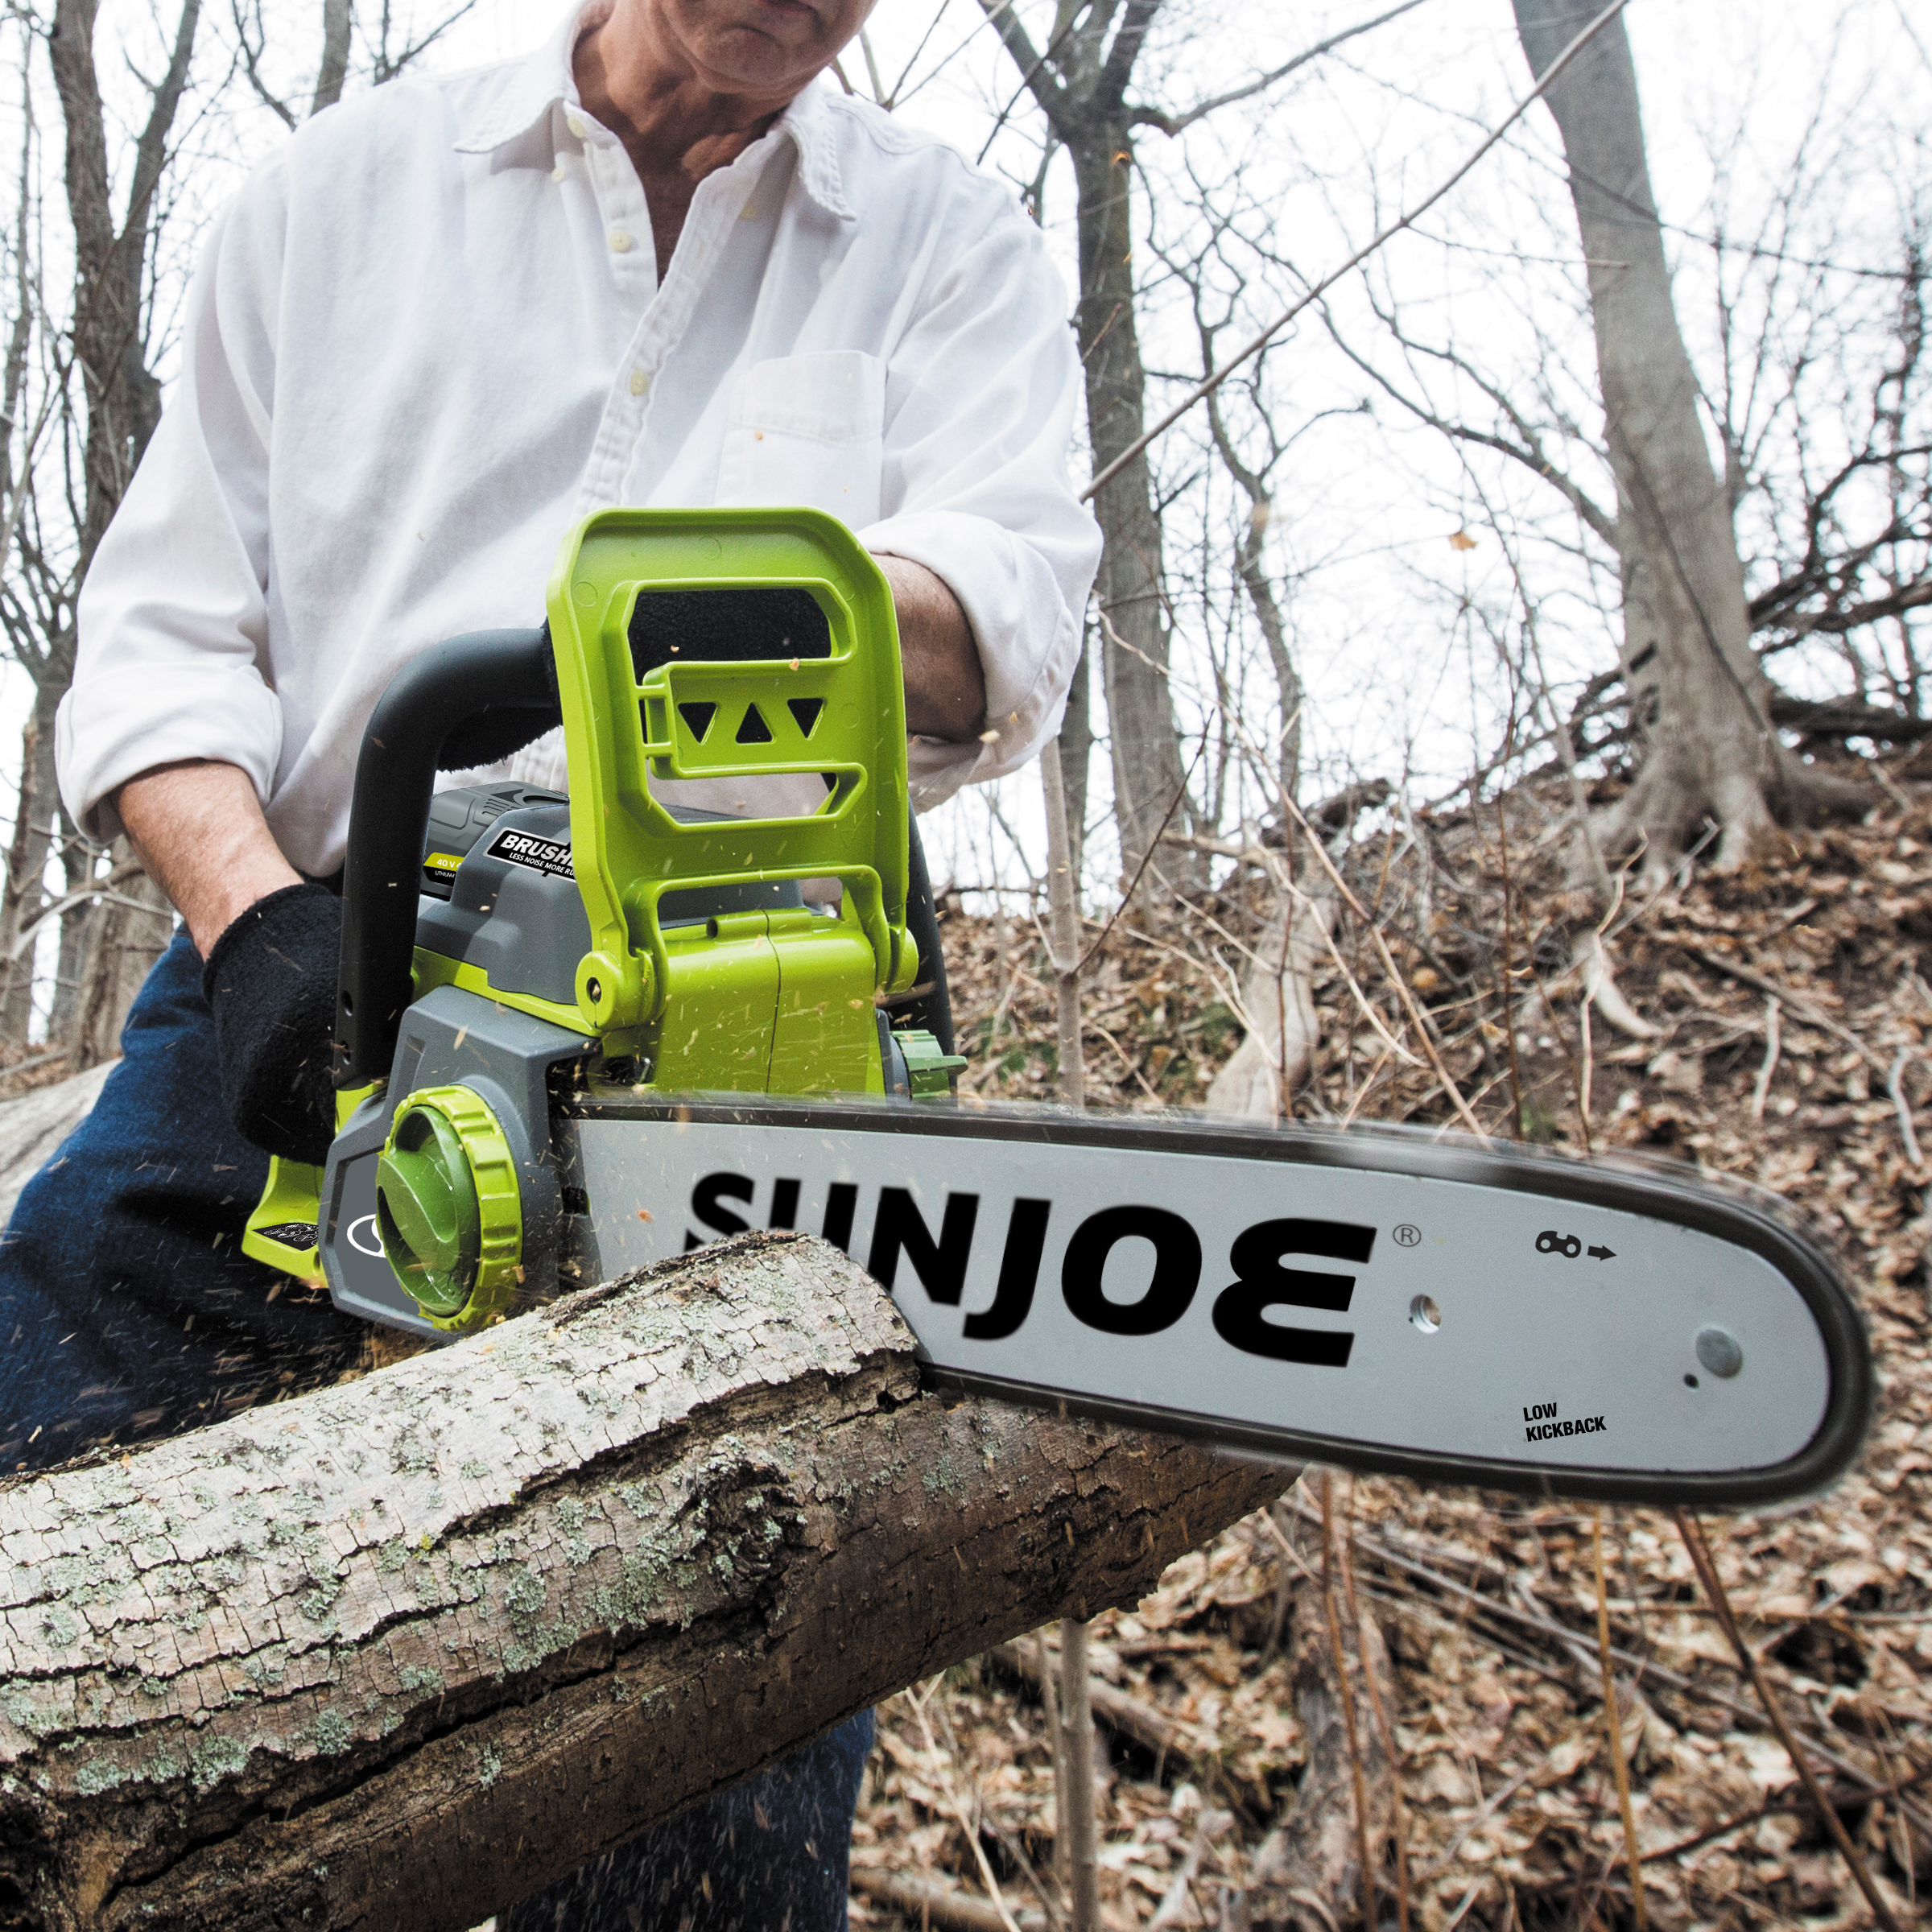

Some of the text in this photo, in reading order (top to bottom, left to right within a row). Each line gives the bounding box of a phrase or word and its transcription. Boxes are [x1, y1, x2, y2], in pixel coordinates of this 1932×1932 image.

[500, 834, 573, 867] BRUSH
[436, 859, 448, 867] 40
[509, 852, 525, 861] LESS
[524, 857, 545, 867] NOISE
[544, 862, 566, 873] MORE
[1523, 1402, 1558, 1422] LOW
[1525, 1416, 1607, 1442] KICKBACK
